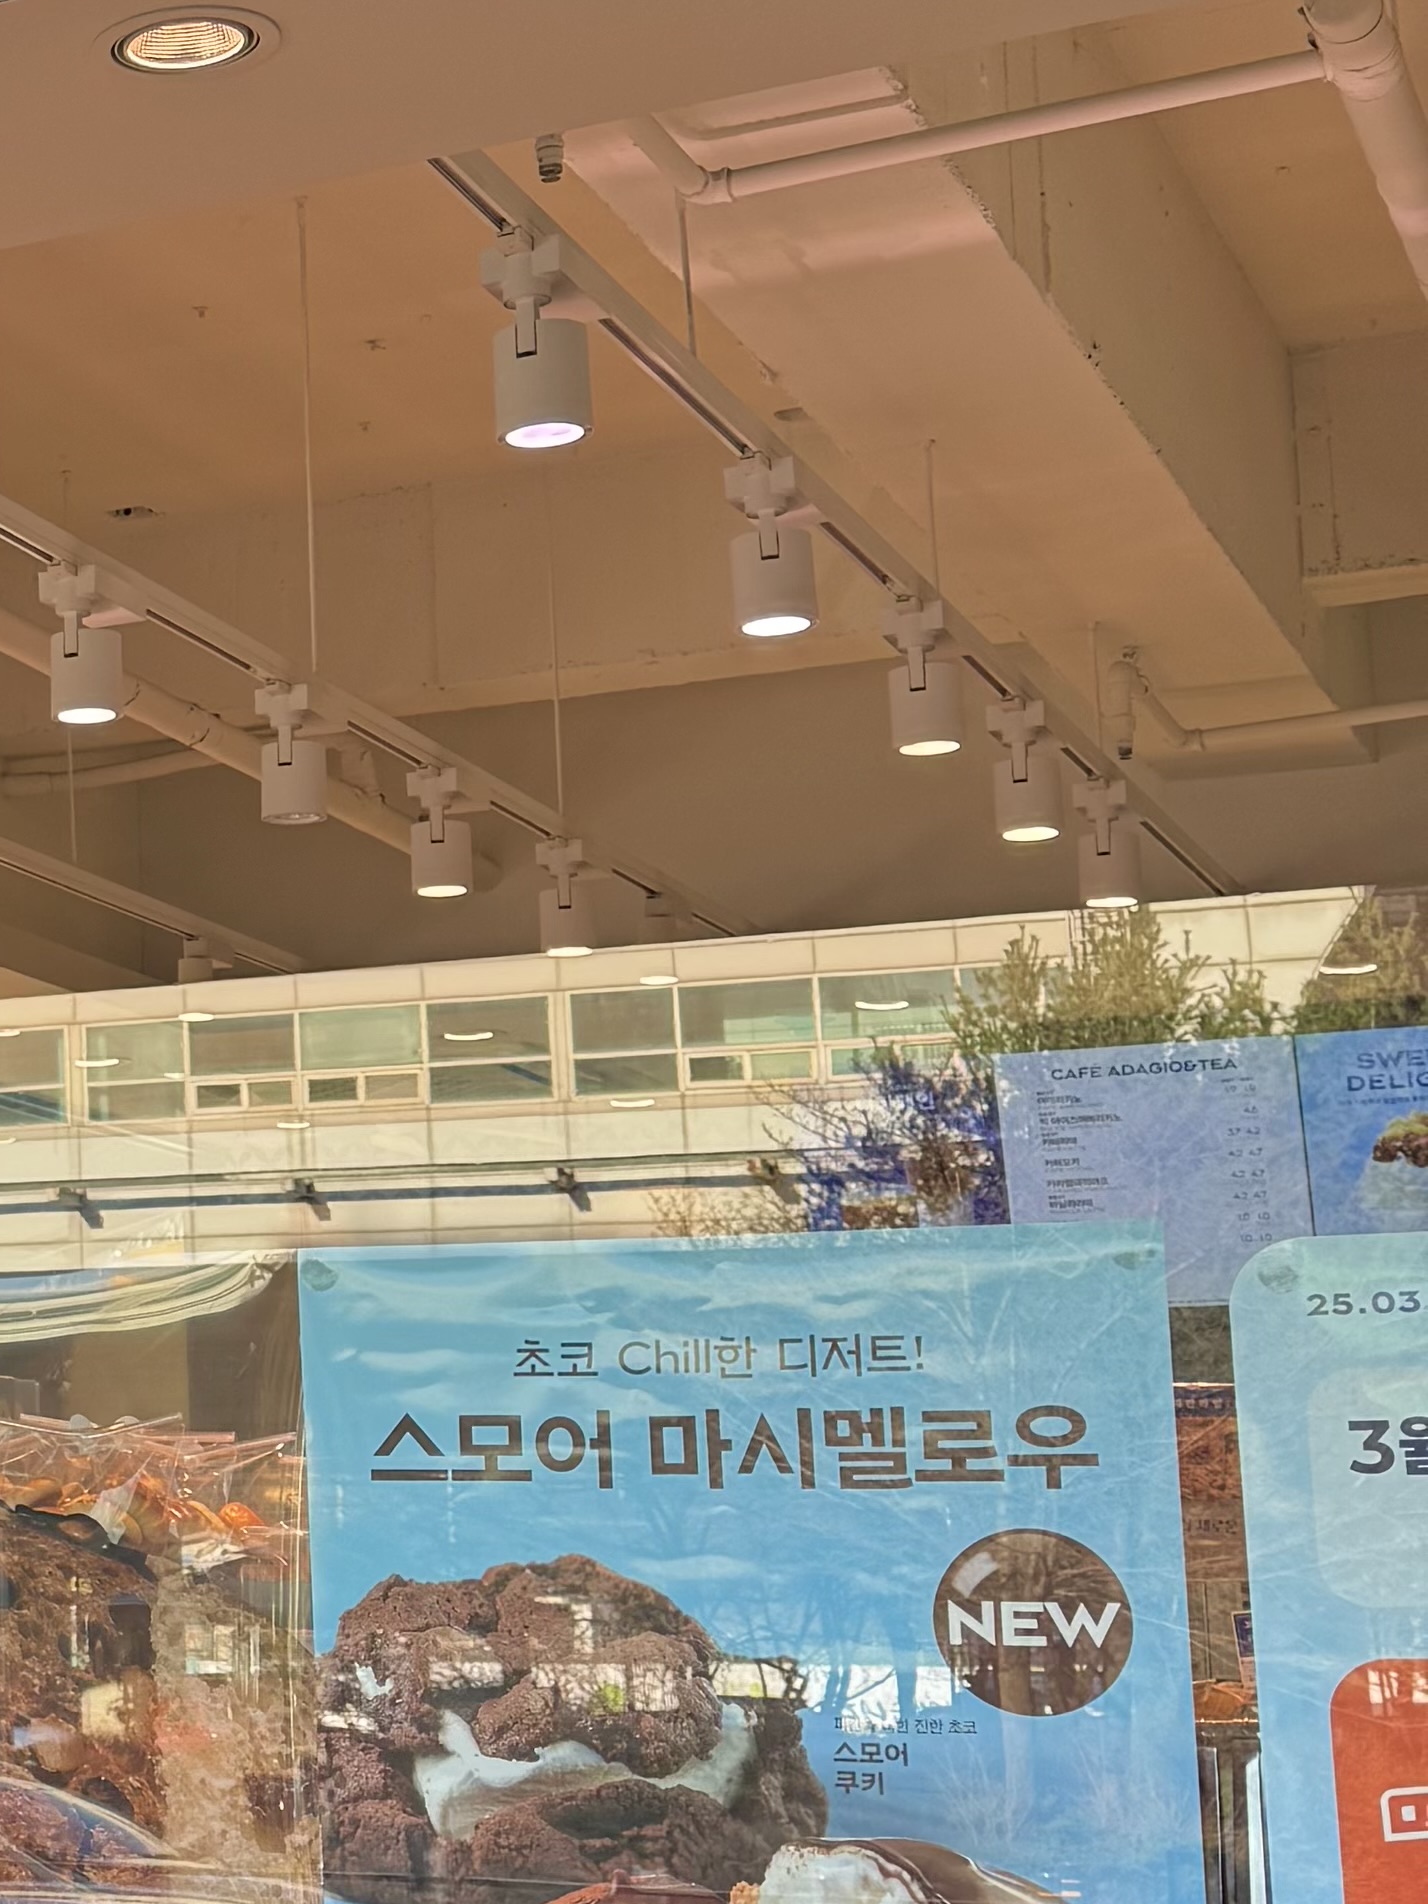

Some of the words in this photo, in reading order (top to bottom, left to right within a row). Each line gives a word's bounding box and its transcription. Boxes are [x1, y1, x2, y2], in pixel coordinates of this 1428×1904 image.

[1357, 1049, 1428, 1069] SWE
[513, 1339, 599, 1377] 초코
[618, 1336, 757, 1379] Chill한
[779, 1333, 924, 1377] 디저트!
[370, 1409, 614, 1490] 스모어
[649, 1404, 1100, 1490] 마시멜로우
[947, 1599, 1121, 1648] NEW
[833, 1741, 909, 1767] 스모어
[834, 1770, 885, 1796] 쿠키
